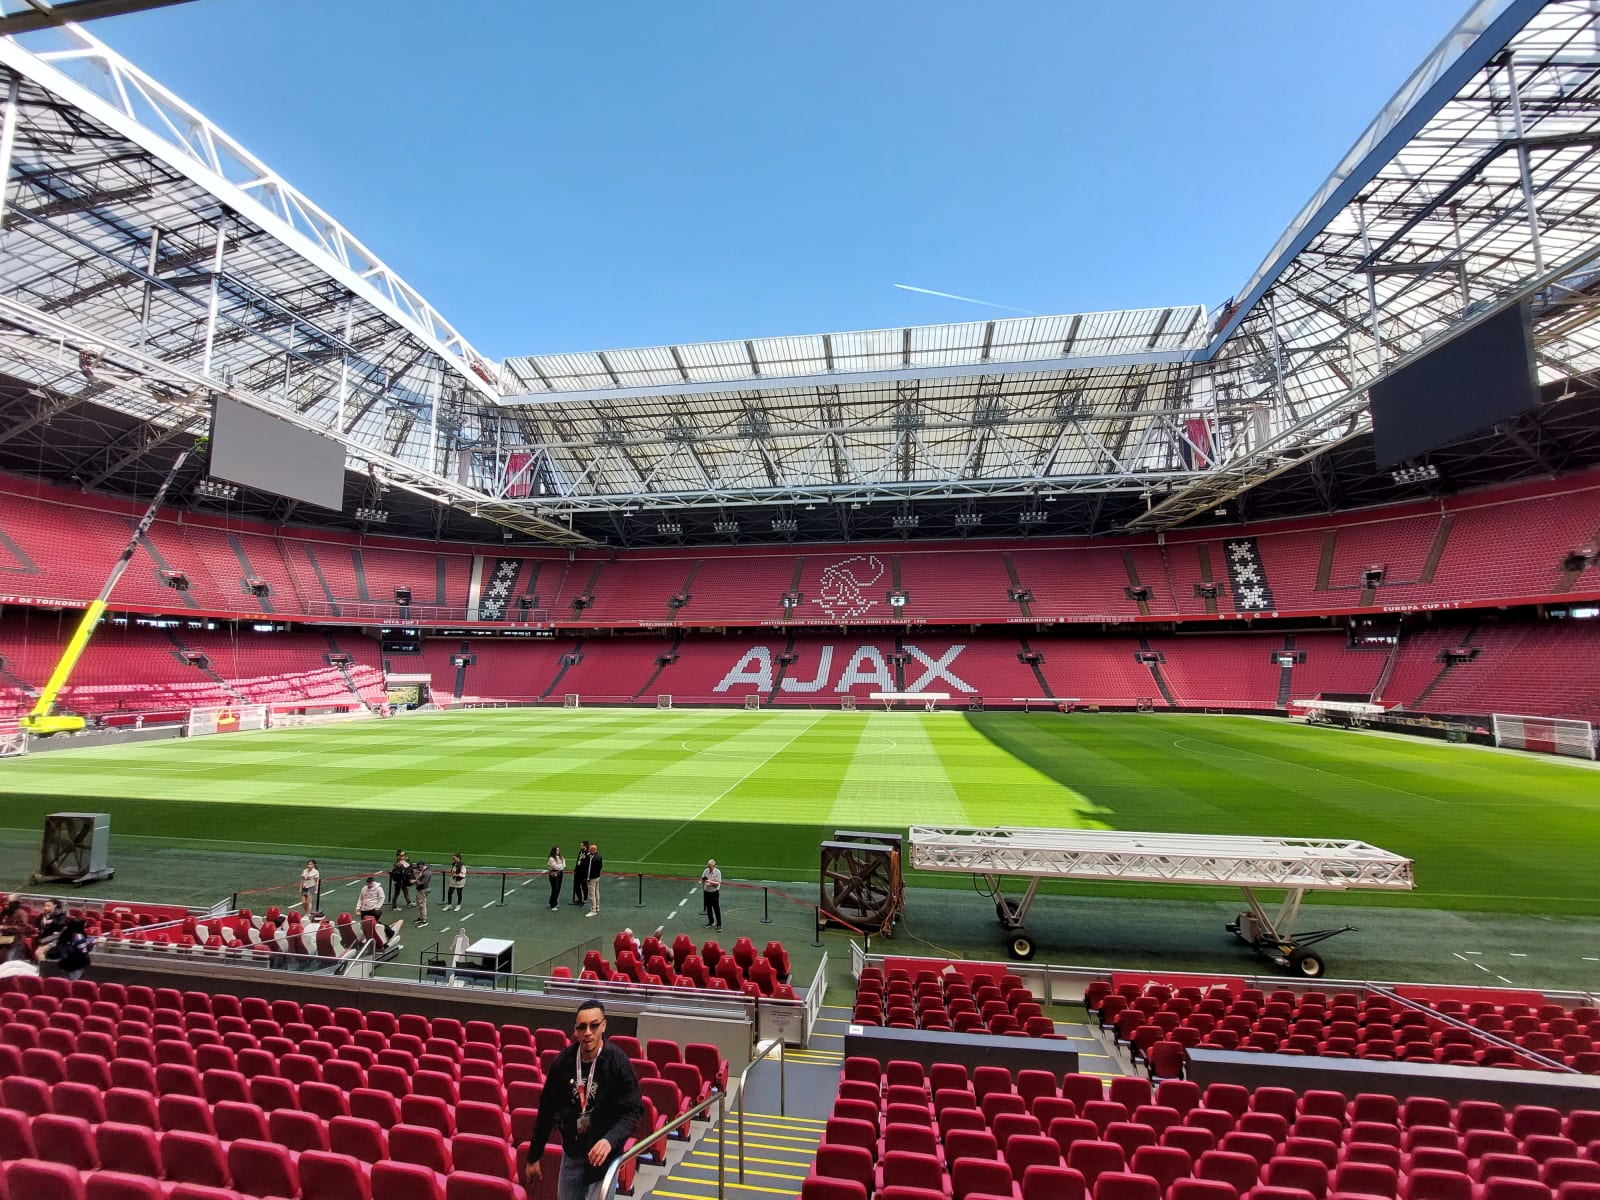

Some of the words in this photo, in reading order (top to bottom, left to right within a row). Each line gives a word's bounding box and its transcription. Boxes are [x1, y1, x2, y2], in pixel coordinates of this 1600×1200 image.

[36, 598, 88, 607] TOEKOMST
[1383, 604, 1419, 612] EUROPA
[712, 645, 979, 693] AJAX
